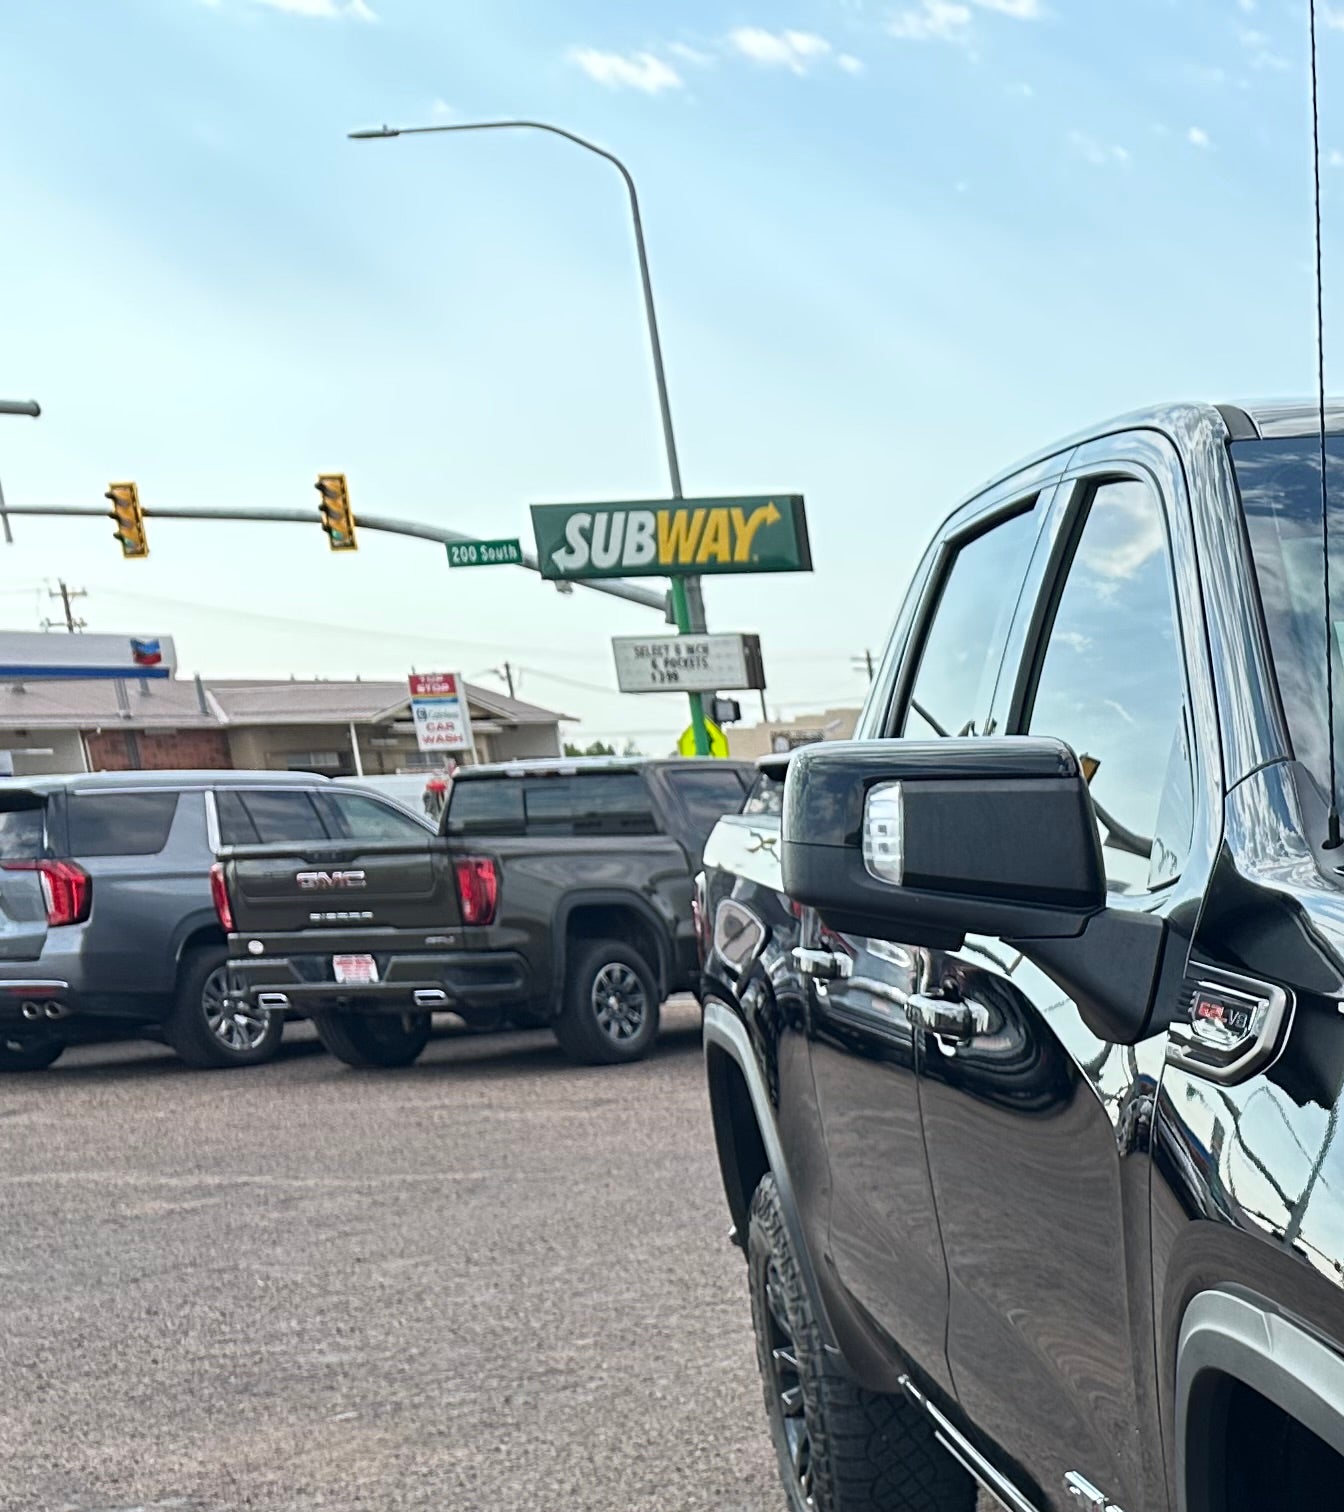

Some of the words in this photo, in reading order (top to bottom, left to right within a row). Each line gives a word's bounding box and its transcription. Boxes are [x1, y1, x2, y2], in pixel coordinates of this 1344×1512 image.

[552, 501, 781, 574] SUBWAY
[451, 545, 478, 563] 200
[480, 544, 518, 561] South
[426, 721, 455, 732] CAR
[422, 734, 464, 744] WASH
[296, 870, 367, 888] GMC
